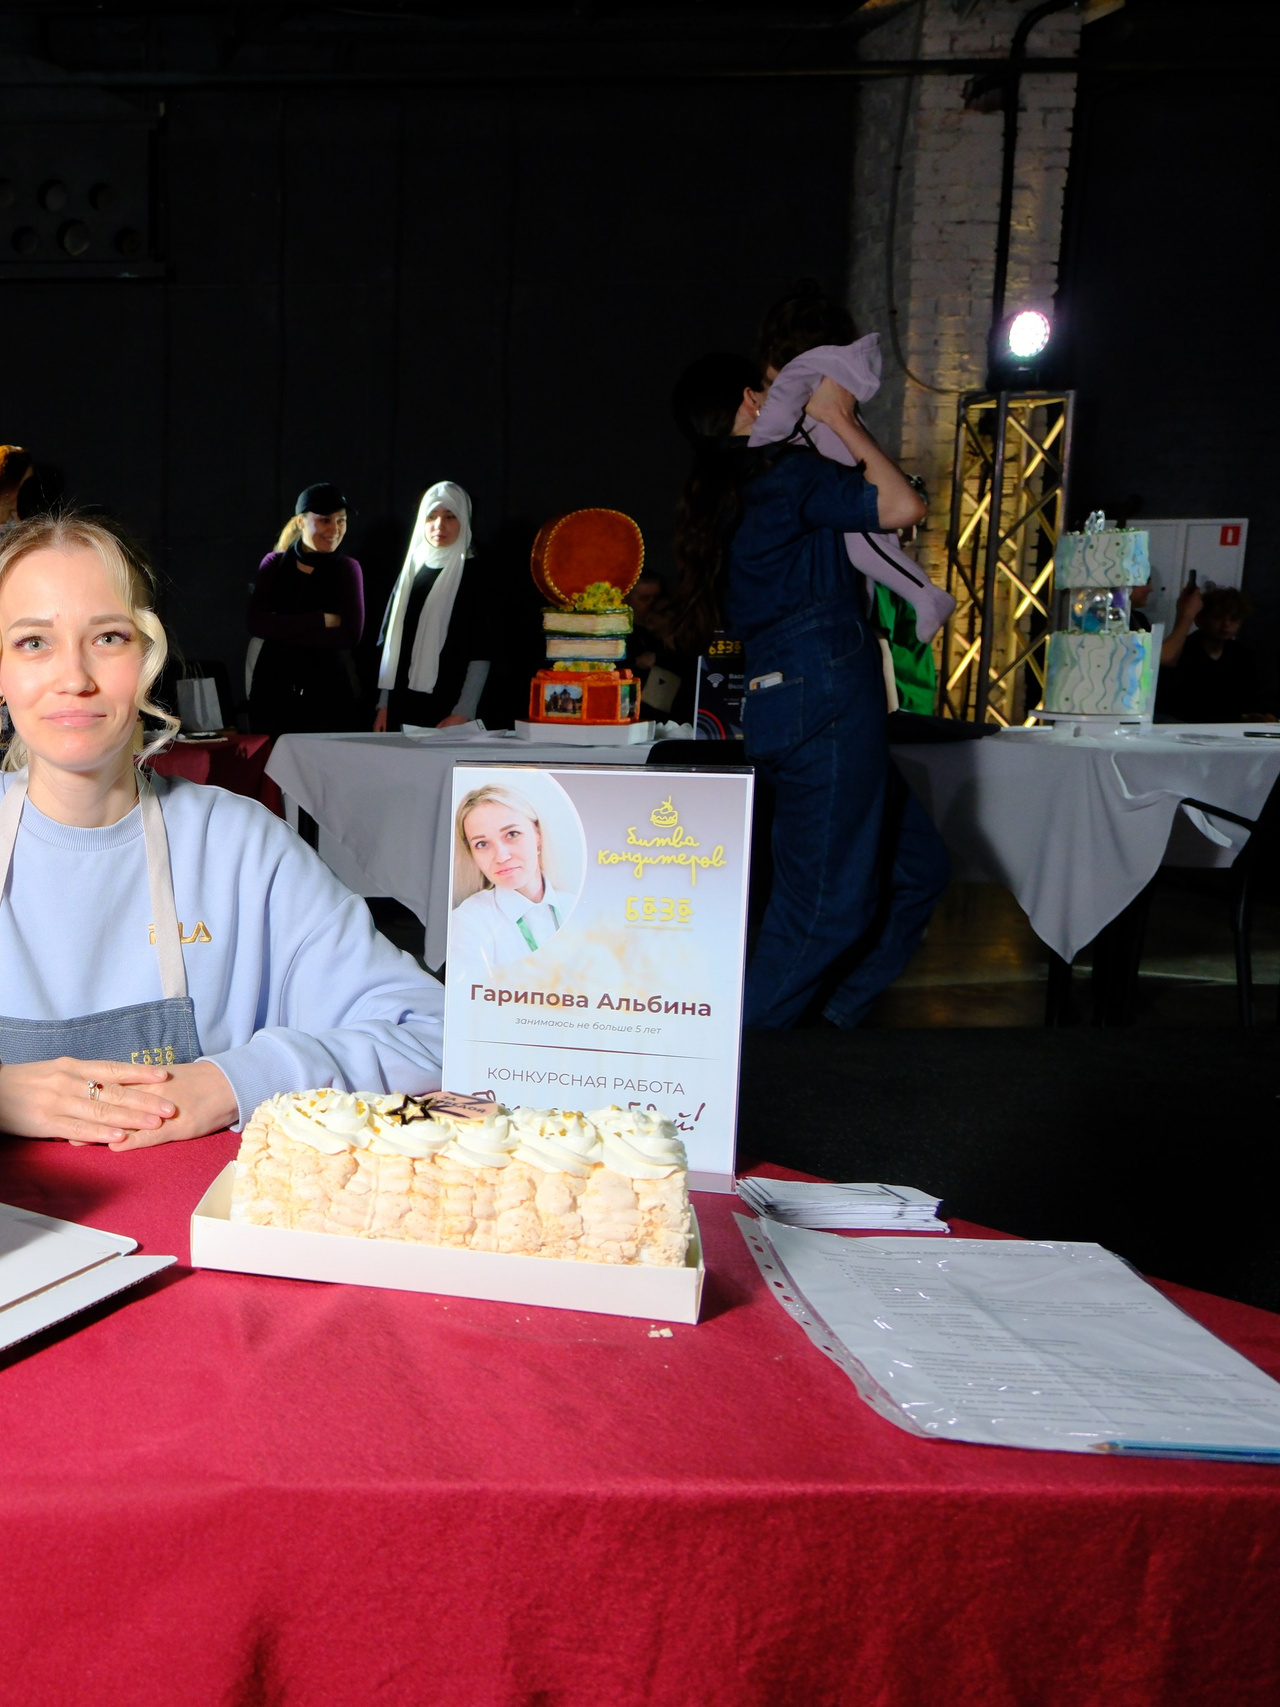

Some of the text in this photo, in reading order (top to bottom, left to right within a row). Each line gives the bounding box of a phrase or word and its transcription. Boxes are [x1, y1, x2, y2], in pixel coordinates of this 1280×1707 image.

[626, 825, 700, 848] битва
[597, 845, 727, 887] кондитеров
[148, 920, 213, 945] FLA
[470, 984, 713, 1017] Гарипова Альбина
[515, 1017, 662, 1035] занимаюсь не больше 5 лет
[487, 1067, 686, 1095] КОНКУРСНАЯ РАБОТА
